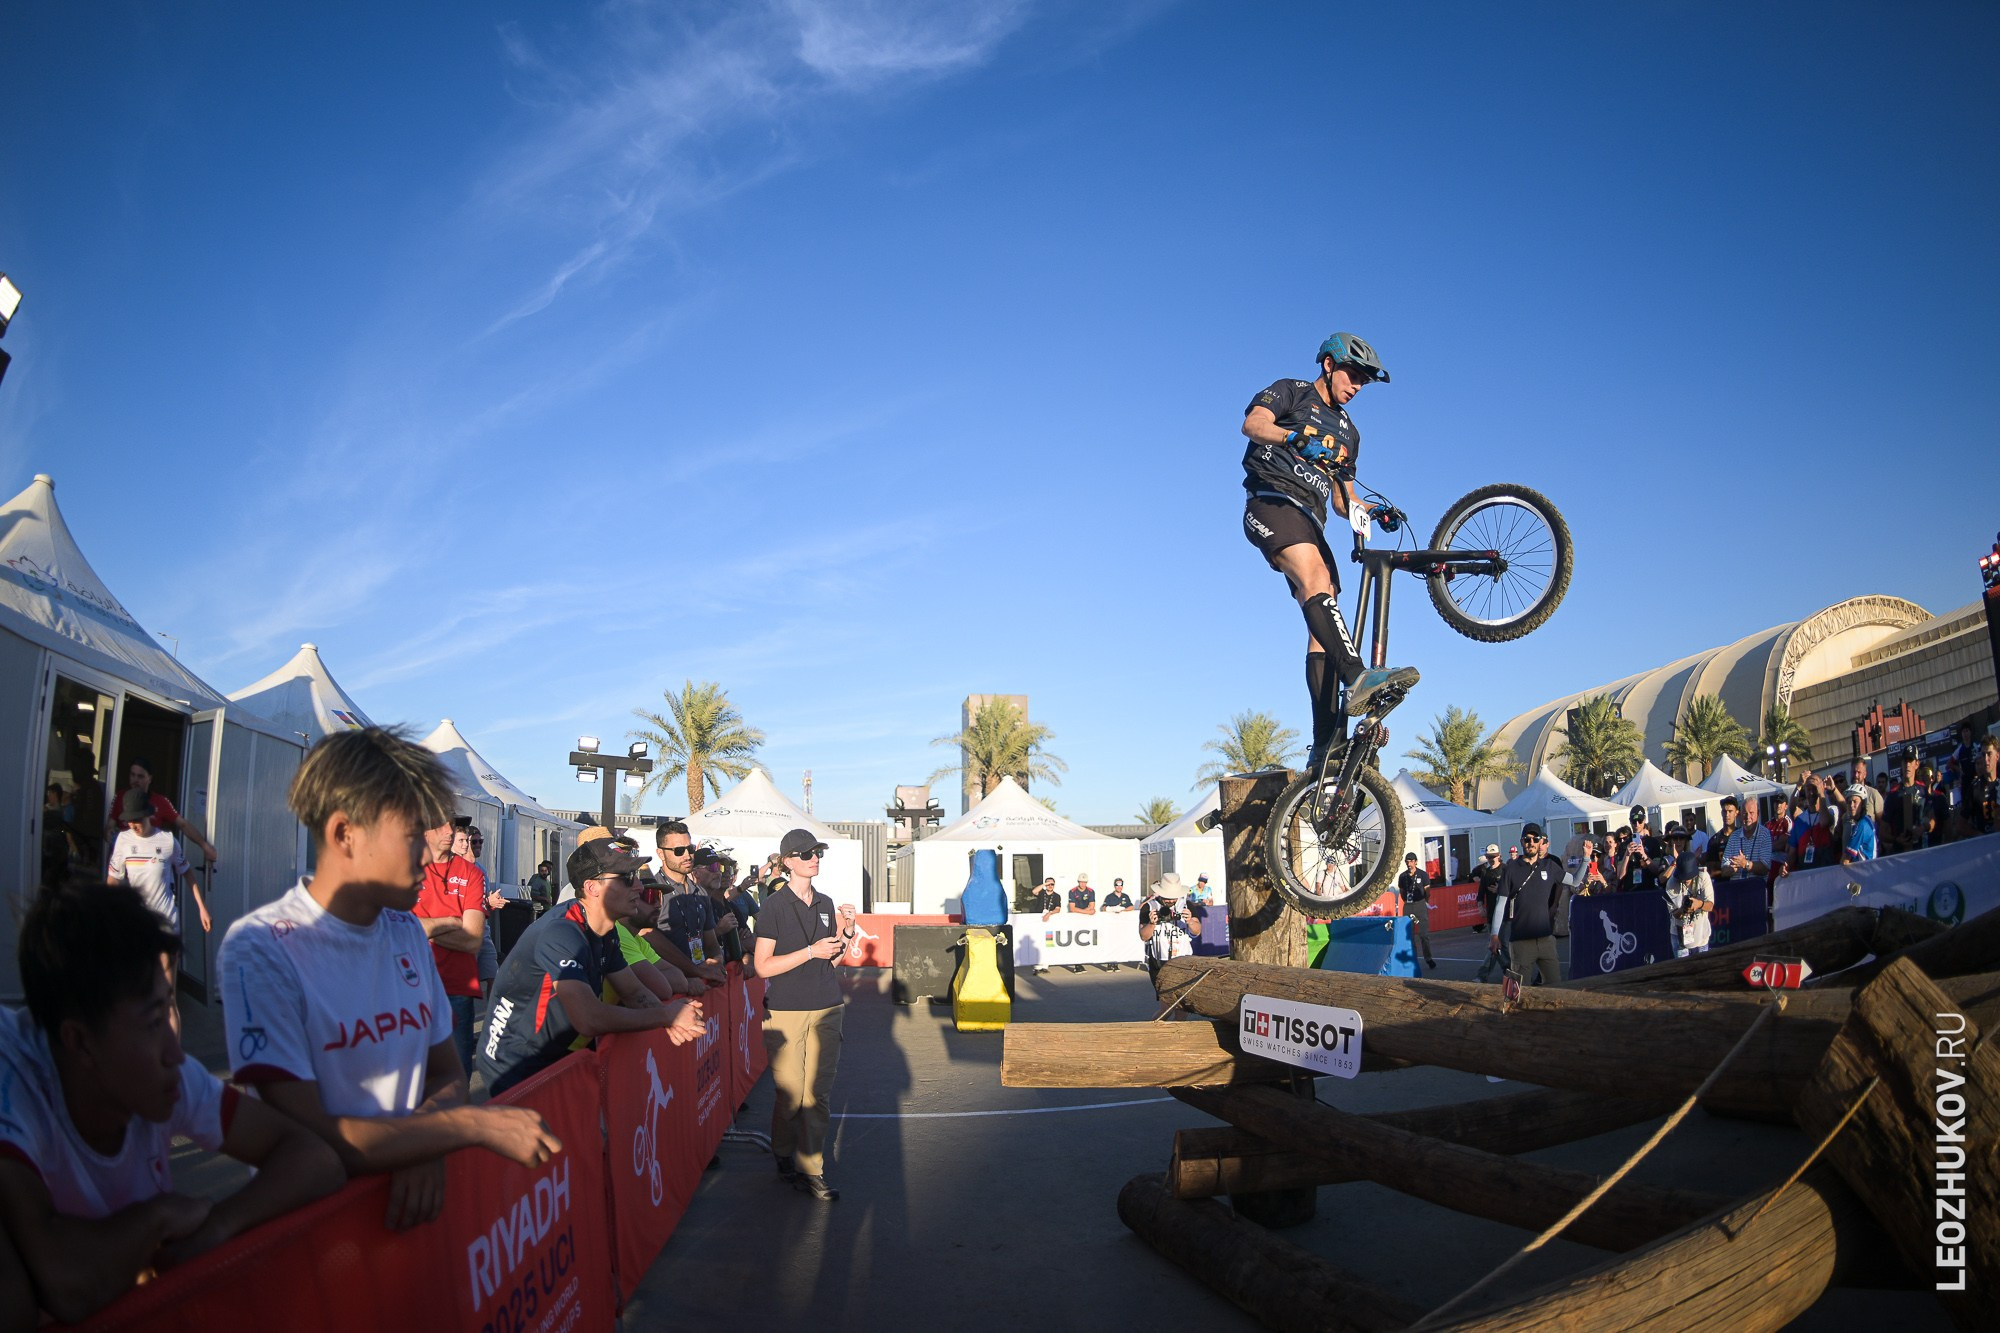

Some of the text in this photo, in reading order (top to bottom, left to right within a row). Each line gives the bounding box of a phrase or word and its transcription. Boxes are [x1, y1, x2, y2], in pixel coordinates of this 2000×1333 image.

[1457, 892, 1478, 903] RIYAD
[1056, 929, 1098, 947] UCI
[485, 996, 515, 1061] ESPAÑA
[1271, 1014, 1356, 1055] TISSOT
[1243, 1036, 1353, 1070] SWISS WATCHES SINCE 1853
[467, 1155, 571, 1313] RIYADH
[540, 1223, 575, 1296] UCI
